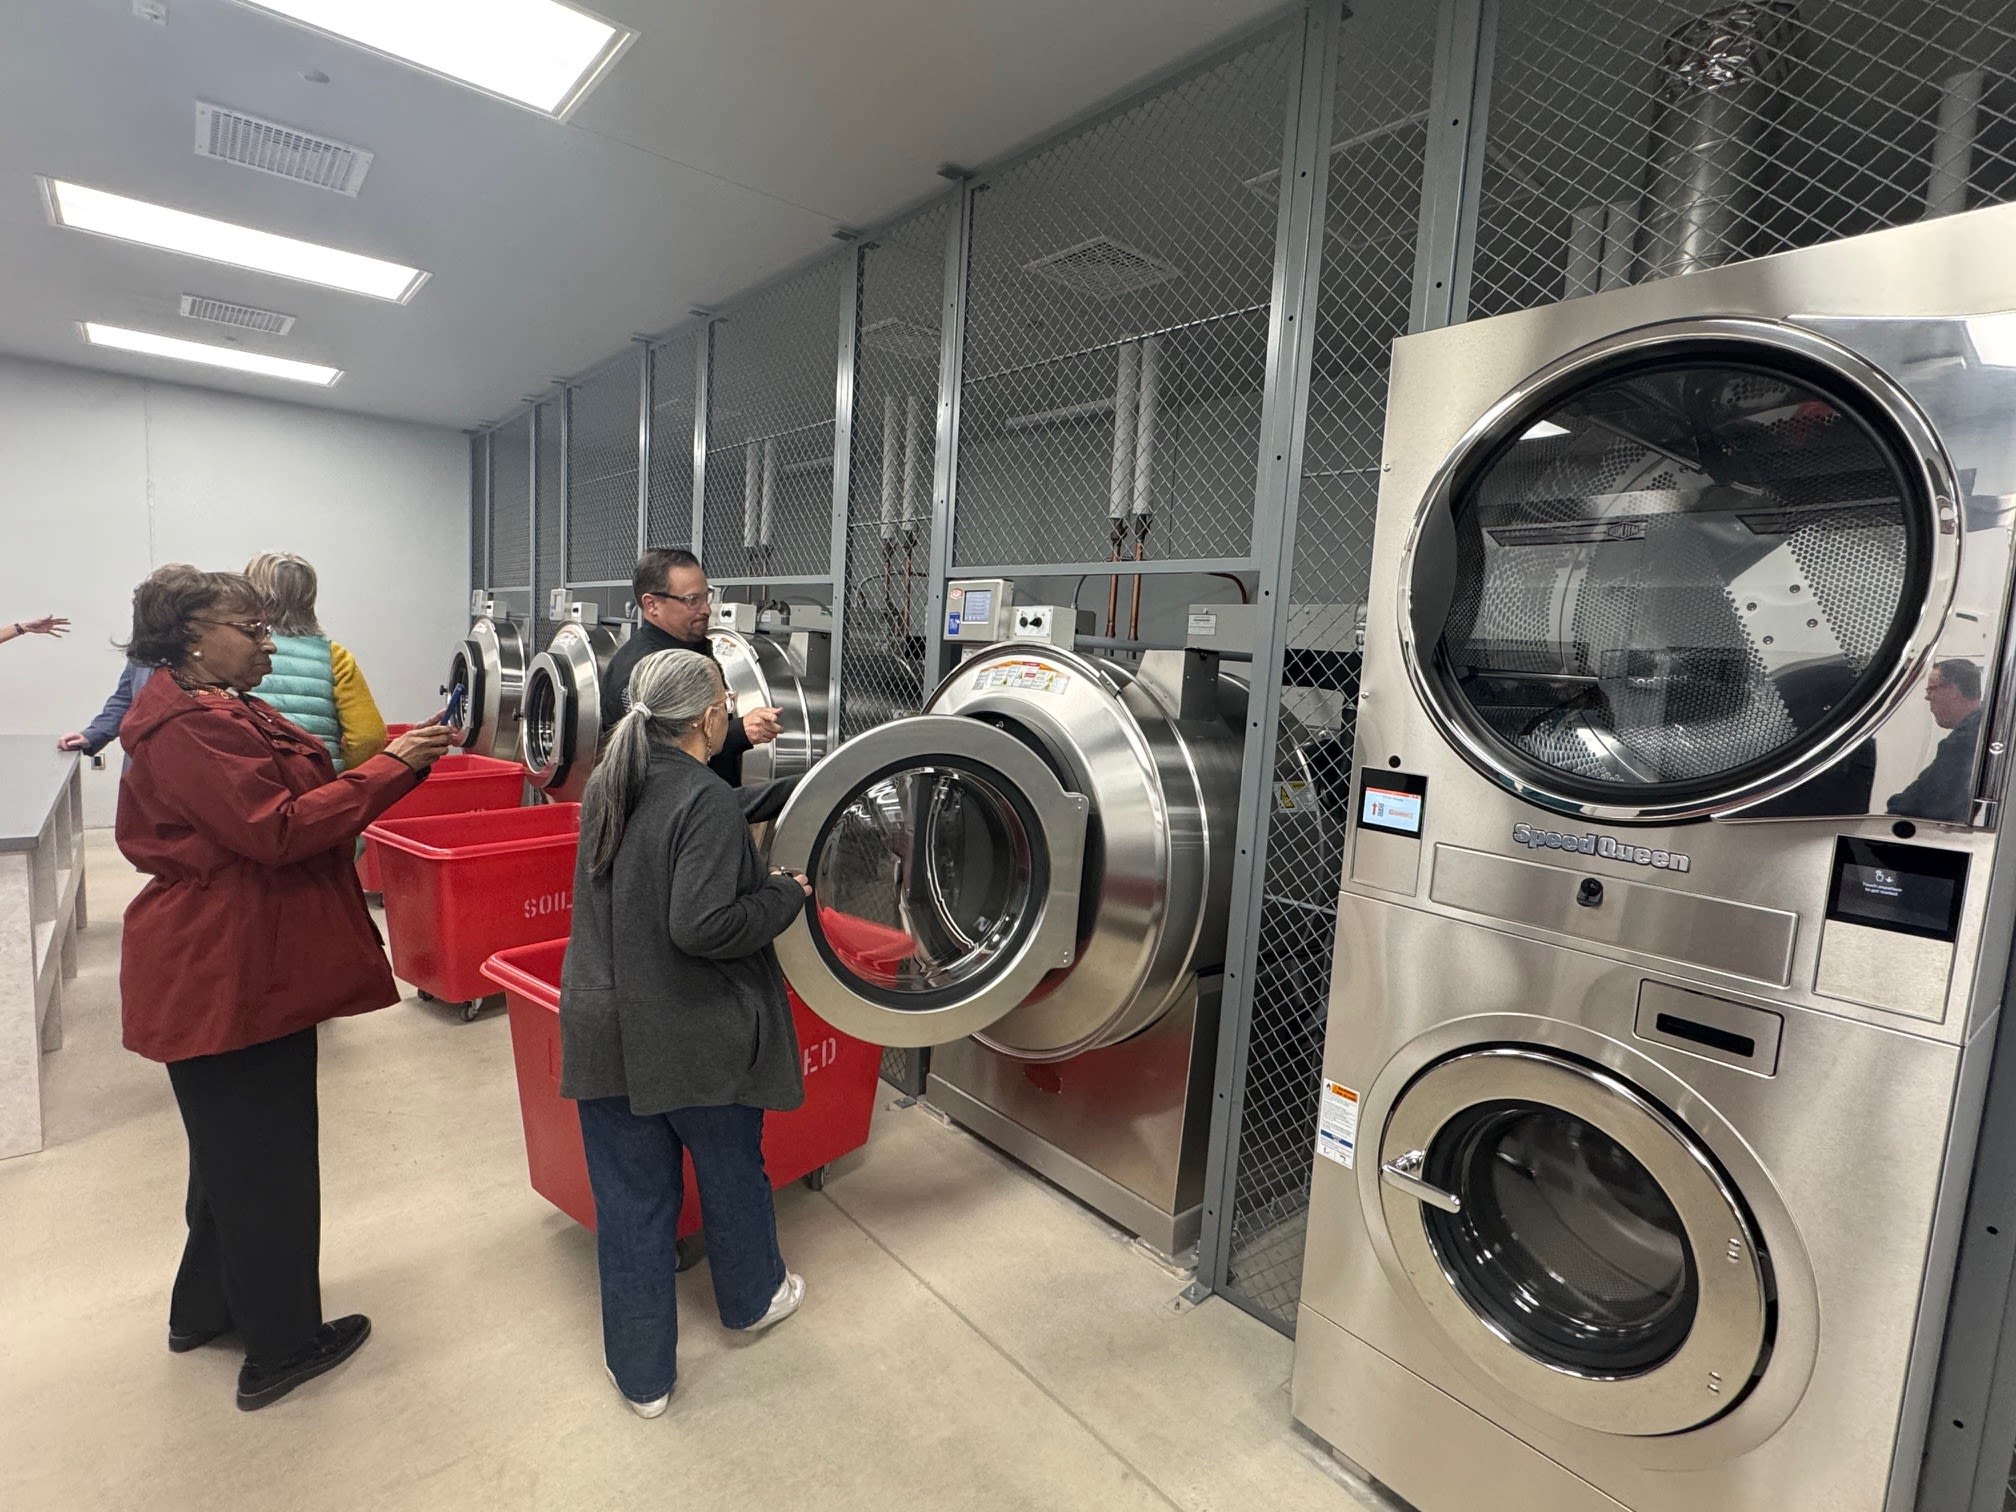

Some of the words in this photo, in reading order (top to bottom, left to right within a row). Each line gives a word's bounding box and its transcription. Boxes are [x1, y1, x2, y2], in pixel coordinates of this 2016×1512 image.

[1513, 822, 1598, 856] Speed
[1597, 836, 1691, 873] Queen
[803, 1036, 837, 1076] ED
